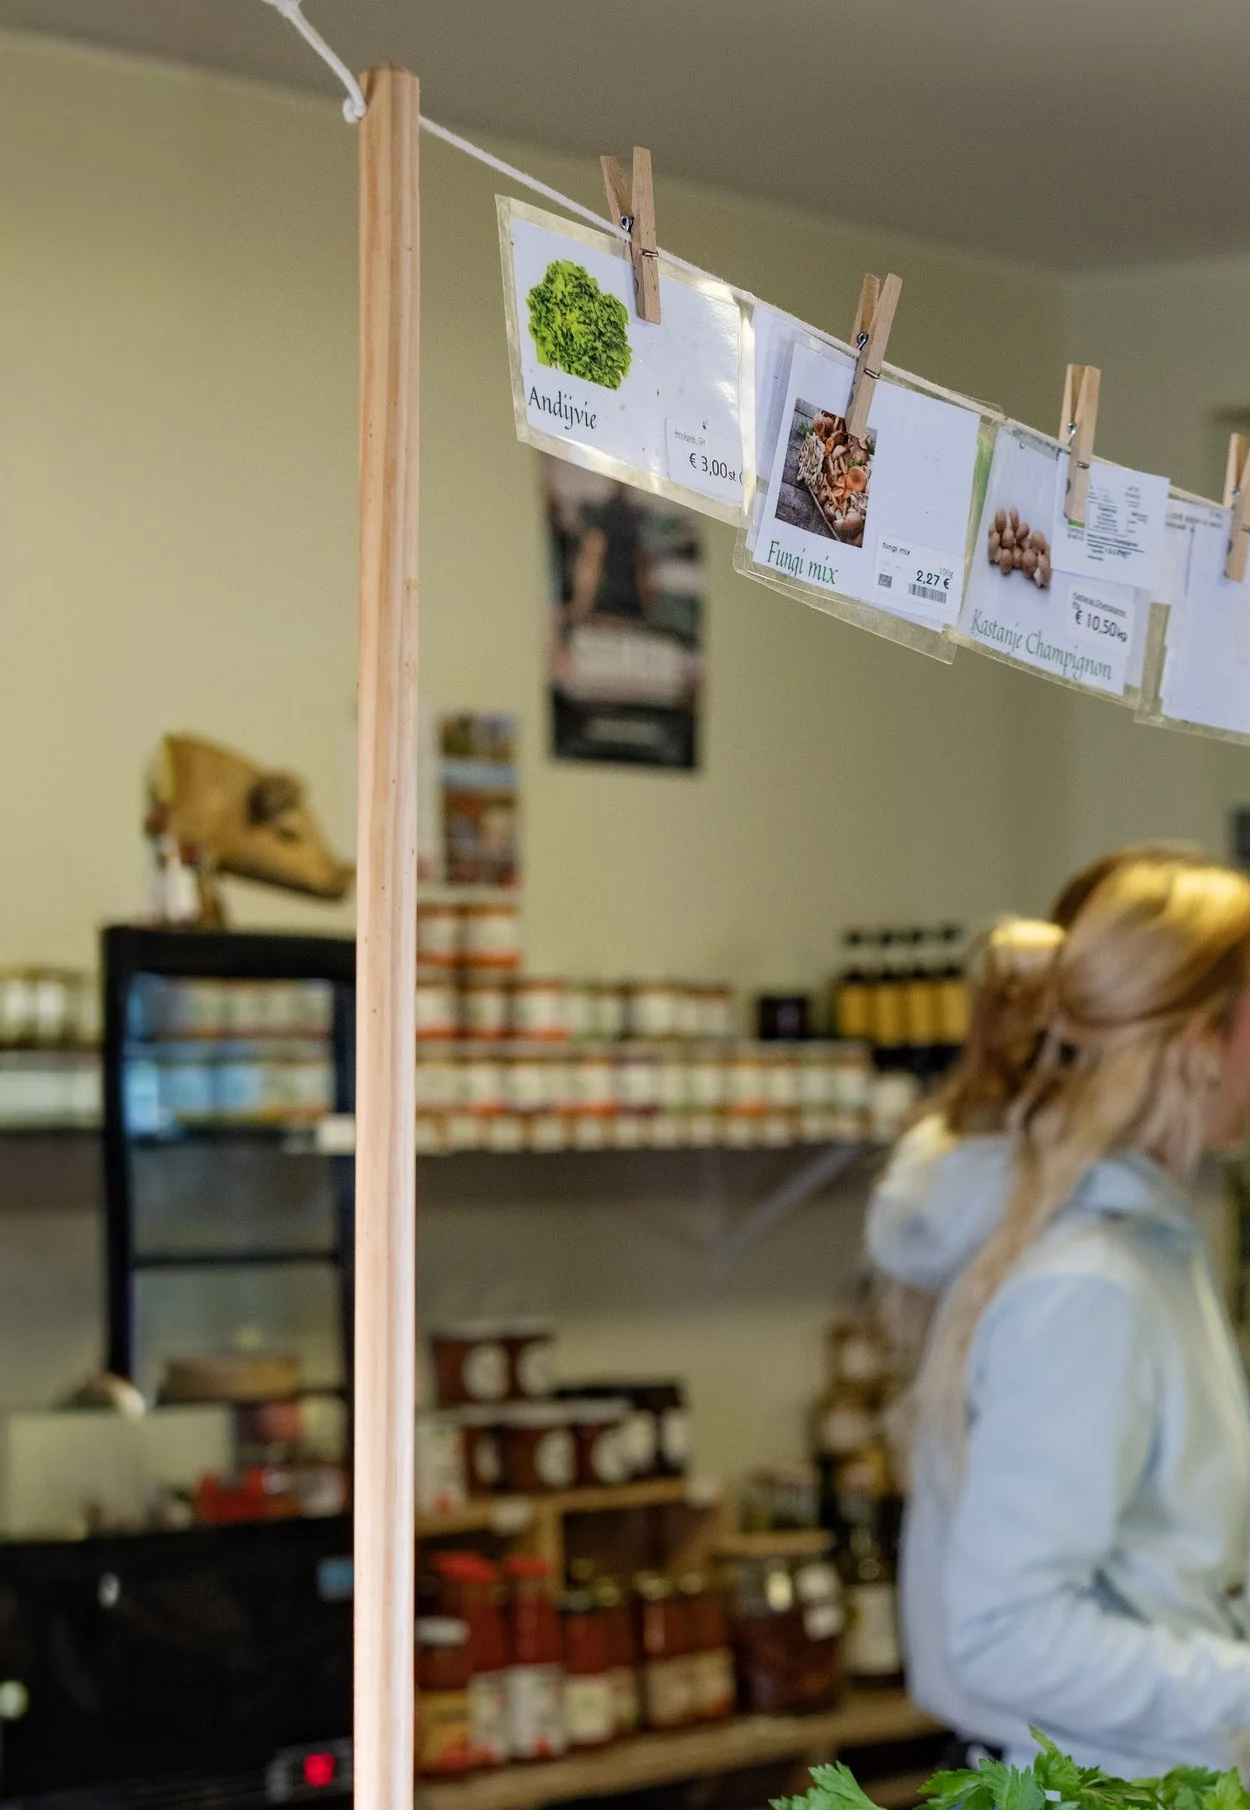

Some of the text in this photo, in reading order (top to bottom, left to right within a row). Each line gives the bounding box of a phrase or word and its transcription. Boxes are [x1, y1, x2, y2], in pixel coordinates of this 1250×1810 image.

[528, 386, 597, 430] Andijvie
[689, 452, 698, 469] €
[767, 540, 839, 585] Fungi mix
[916, 570, 951, 590] 2,27 €
[1075, 609, 1083, 625] €
[971, 608, 1112, 681] Kastanje Champignon
